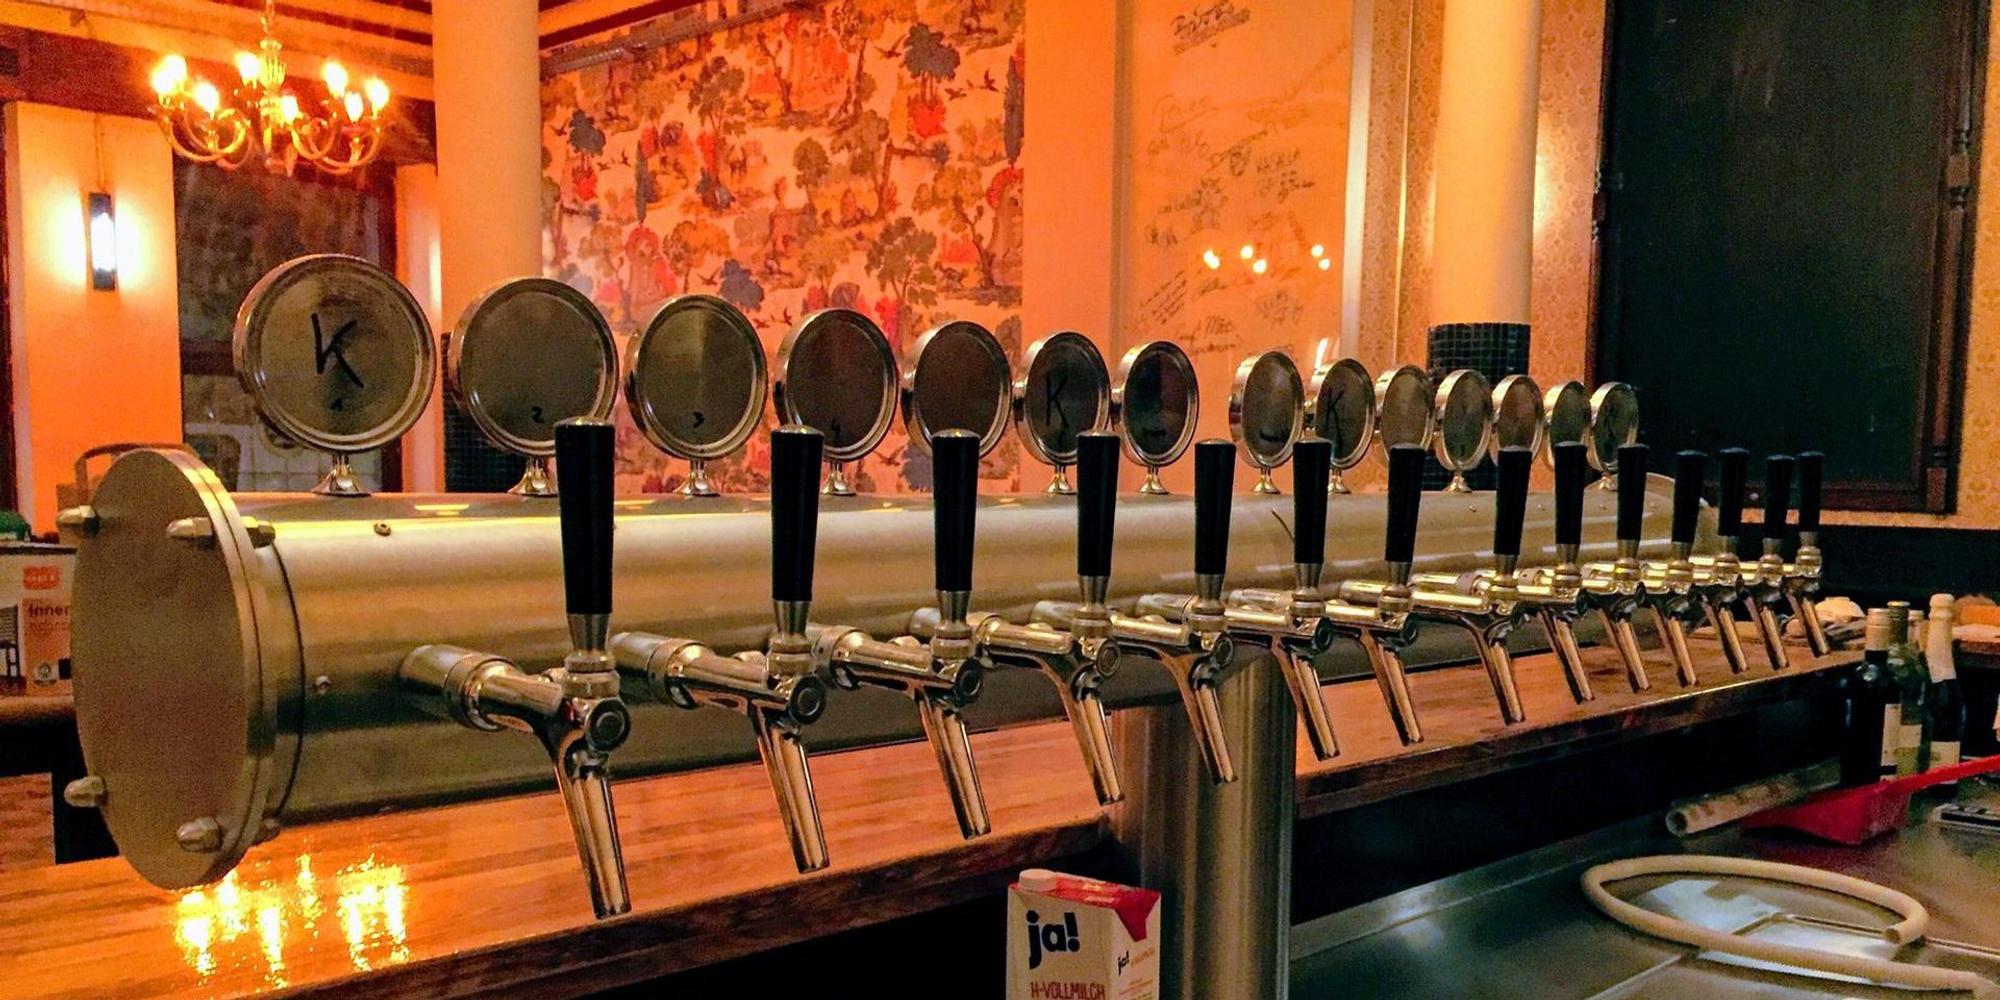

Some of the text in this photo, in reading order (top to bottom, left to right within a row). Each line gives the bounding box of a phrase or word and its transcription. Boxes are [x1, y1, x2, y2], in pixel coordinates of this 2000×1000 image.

[311, 312, 364, 388] K
[1045, 370, 1069, 430] K
[531, 406, 545, 424] 2
[693, 411, 705, 429] 3
[1026, 910, 1080, 970] ja!
[1117, 950, 1130, 976] ja!
[1030, 980, 1106, 1000] H-VOLLMILCH
